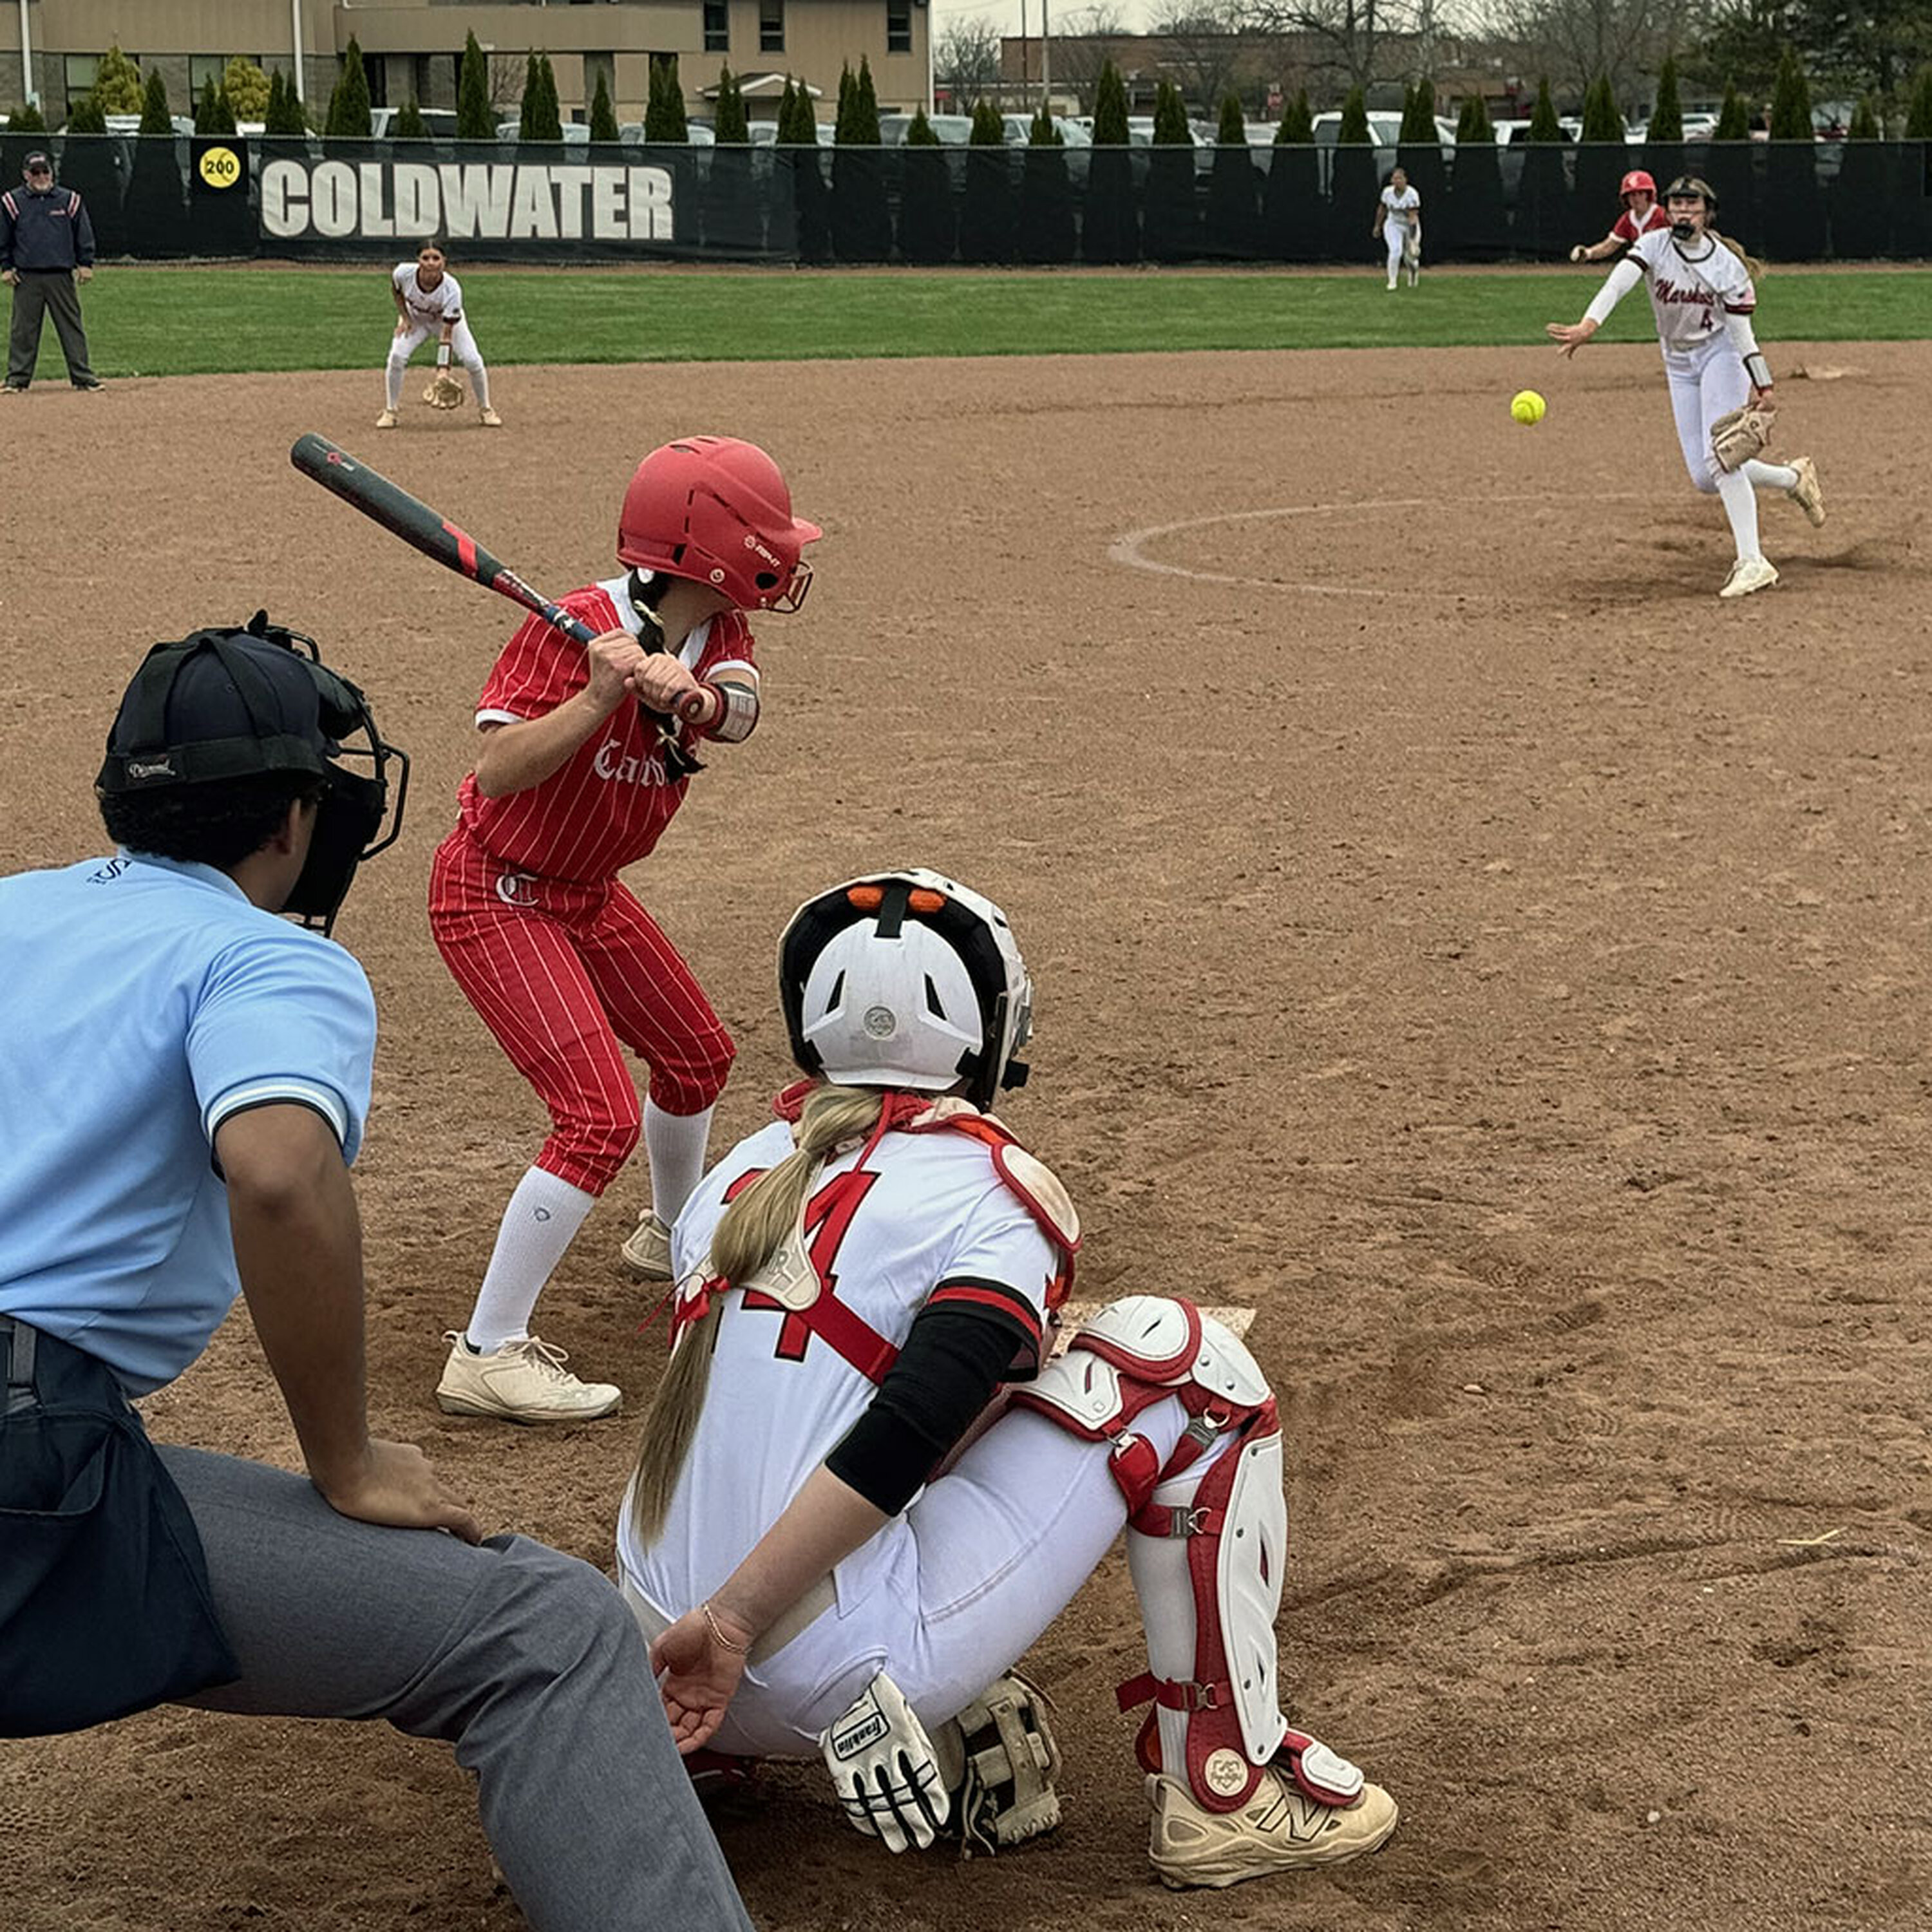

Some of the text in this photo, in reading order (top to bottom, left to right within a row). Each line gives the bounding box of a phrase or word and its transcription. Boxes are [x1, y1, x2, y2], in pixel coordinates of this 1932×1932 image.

[206, 160, 235, 175] 200
[261, 160, 673, 240] COLDWATER
[1700, 307, 1714, 332] 4
